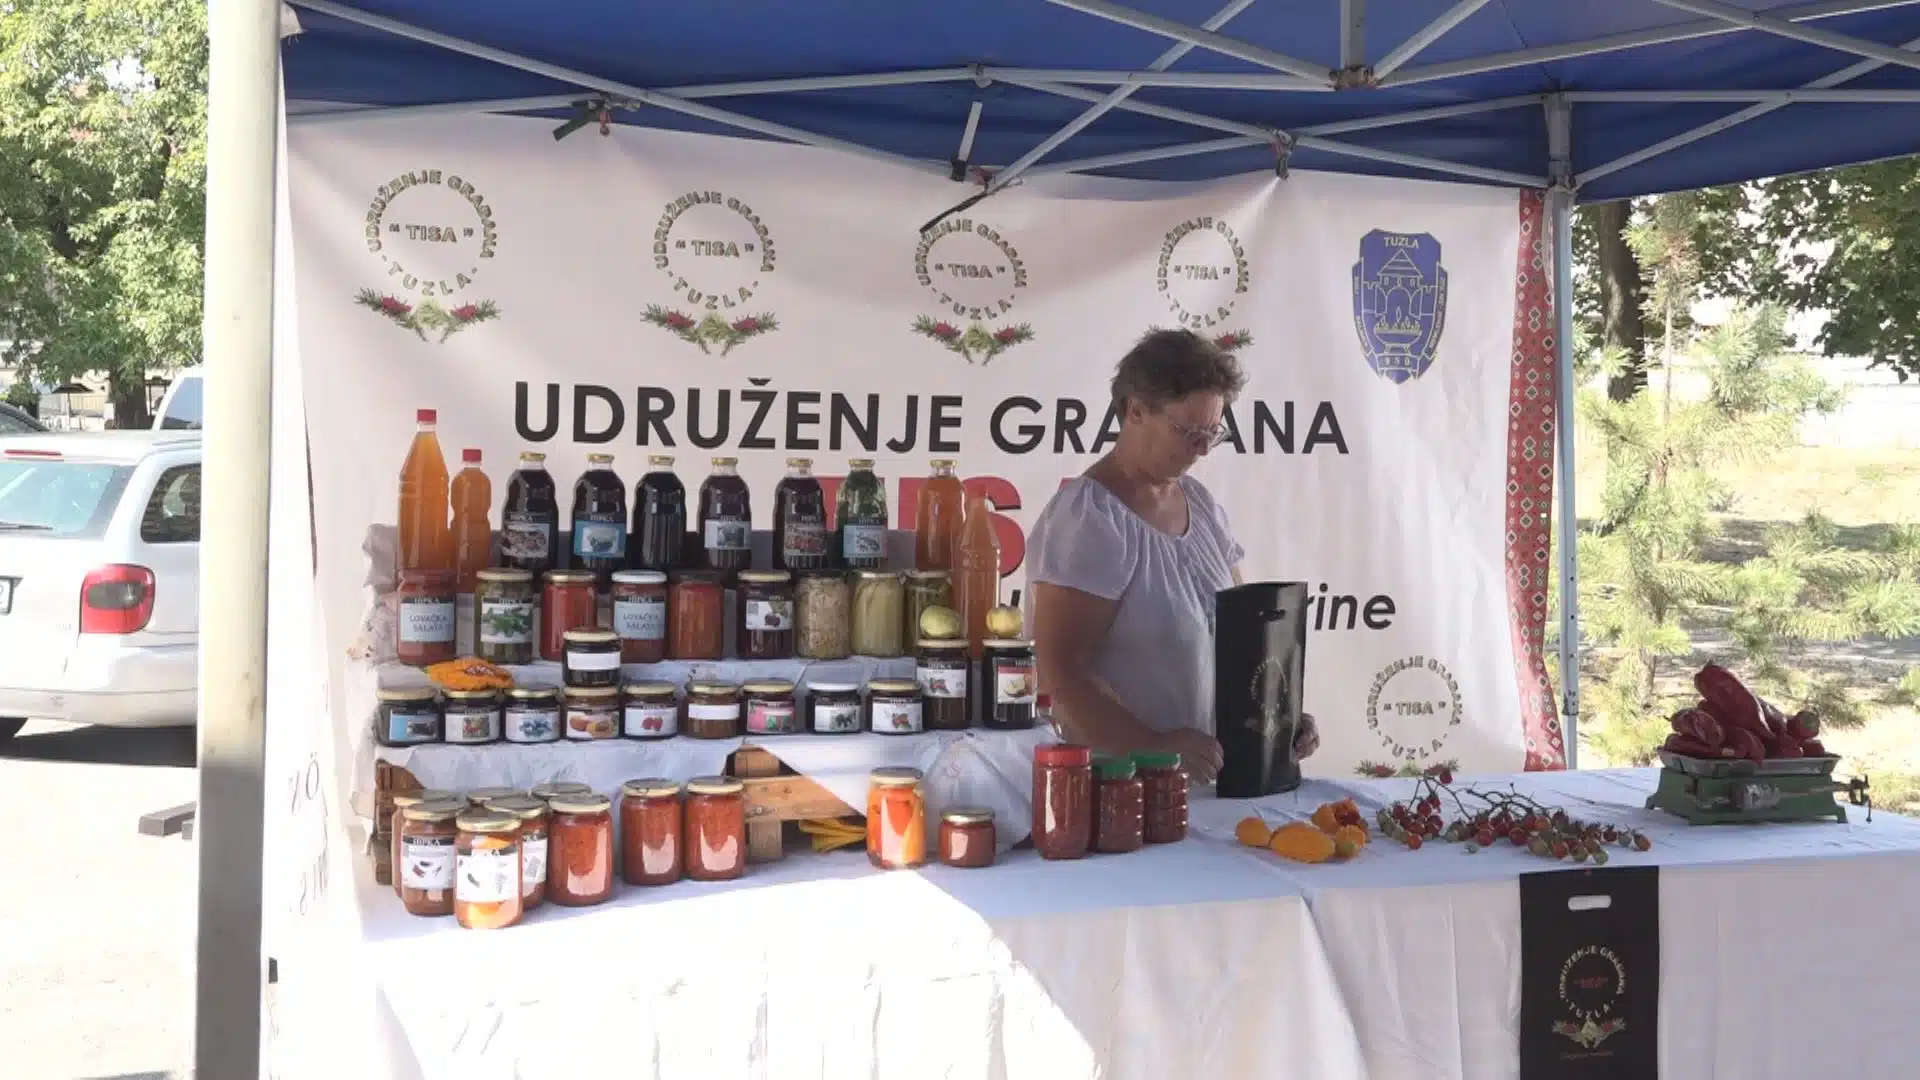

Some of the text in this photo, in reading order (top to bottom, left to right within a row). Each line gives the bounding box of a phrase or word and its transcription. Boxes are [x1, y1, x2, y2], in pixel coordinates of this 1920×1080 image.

[1384, 237, 1420, 249] TUZLA
[514, 377, 1349, 454] UDRUŽENJE GRAANA
